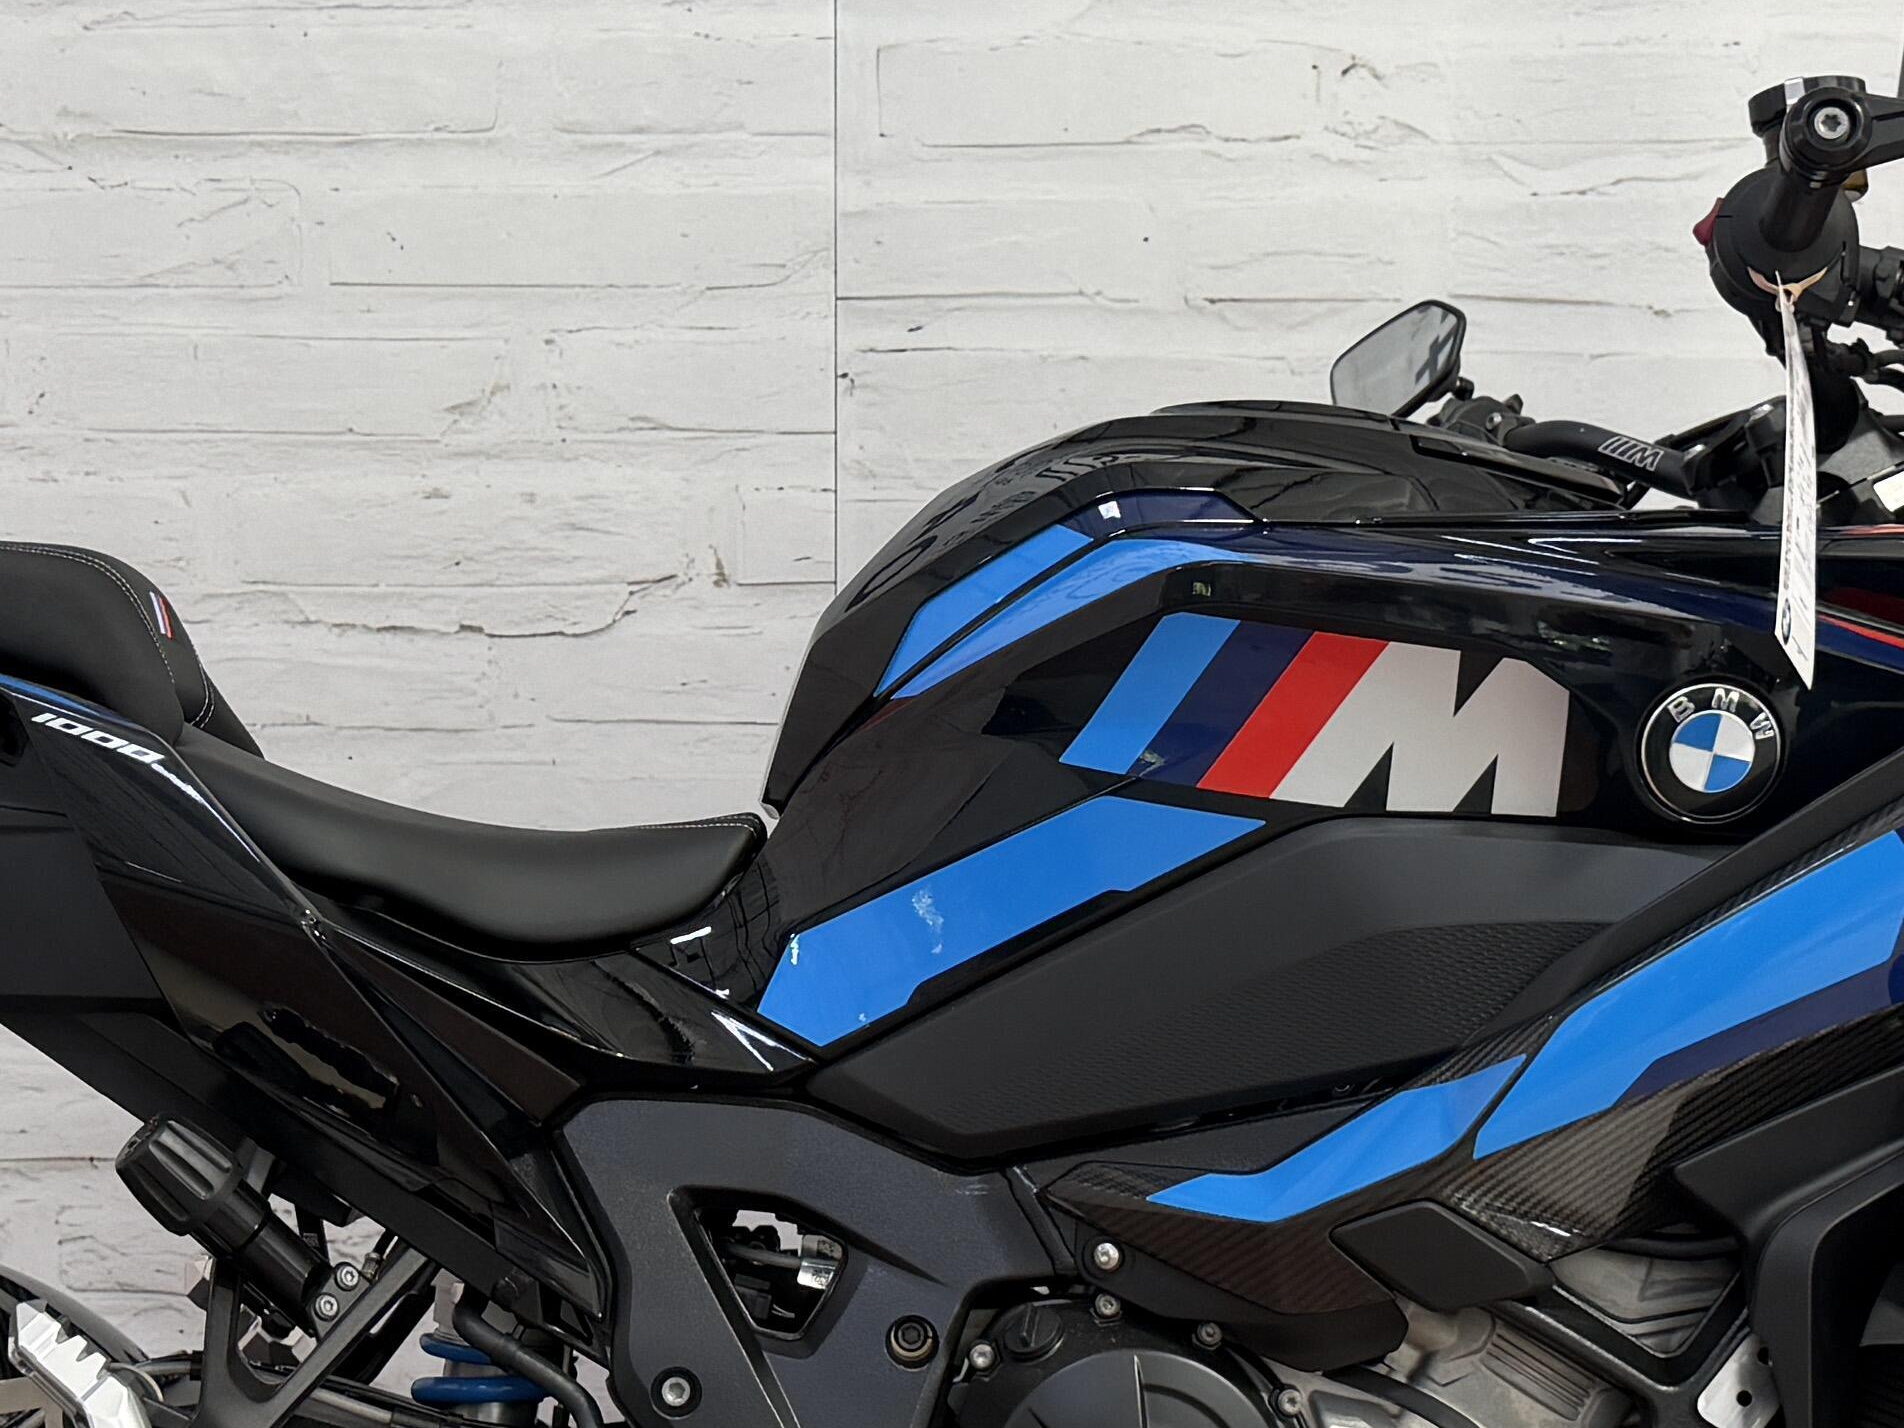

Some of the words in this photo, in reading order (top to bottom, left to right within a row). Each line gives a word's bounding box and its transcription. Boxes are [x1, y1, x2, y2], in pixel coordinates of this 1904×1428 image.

[31, 712, 166, 764] 1000
[1268, 640, 1571, 818] M
[1667, 686, 1775, 741] BMW
